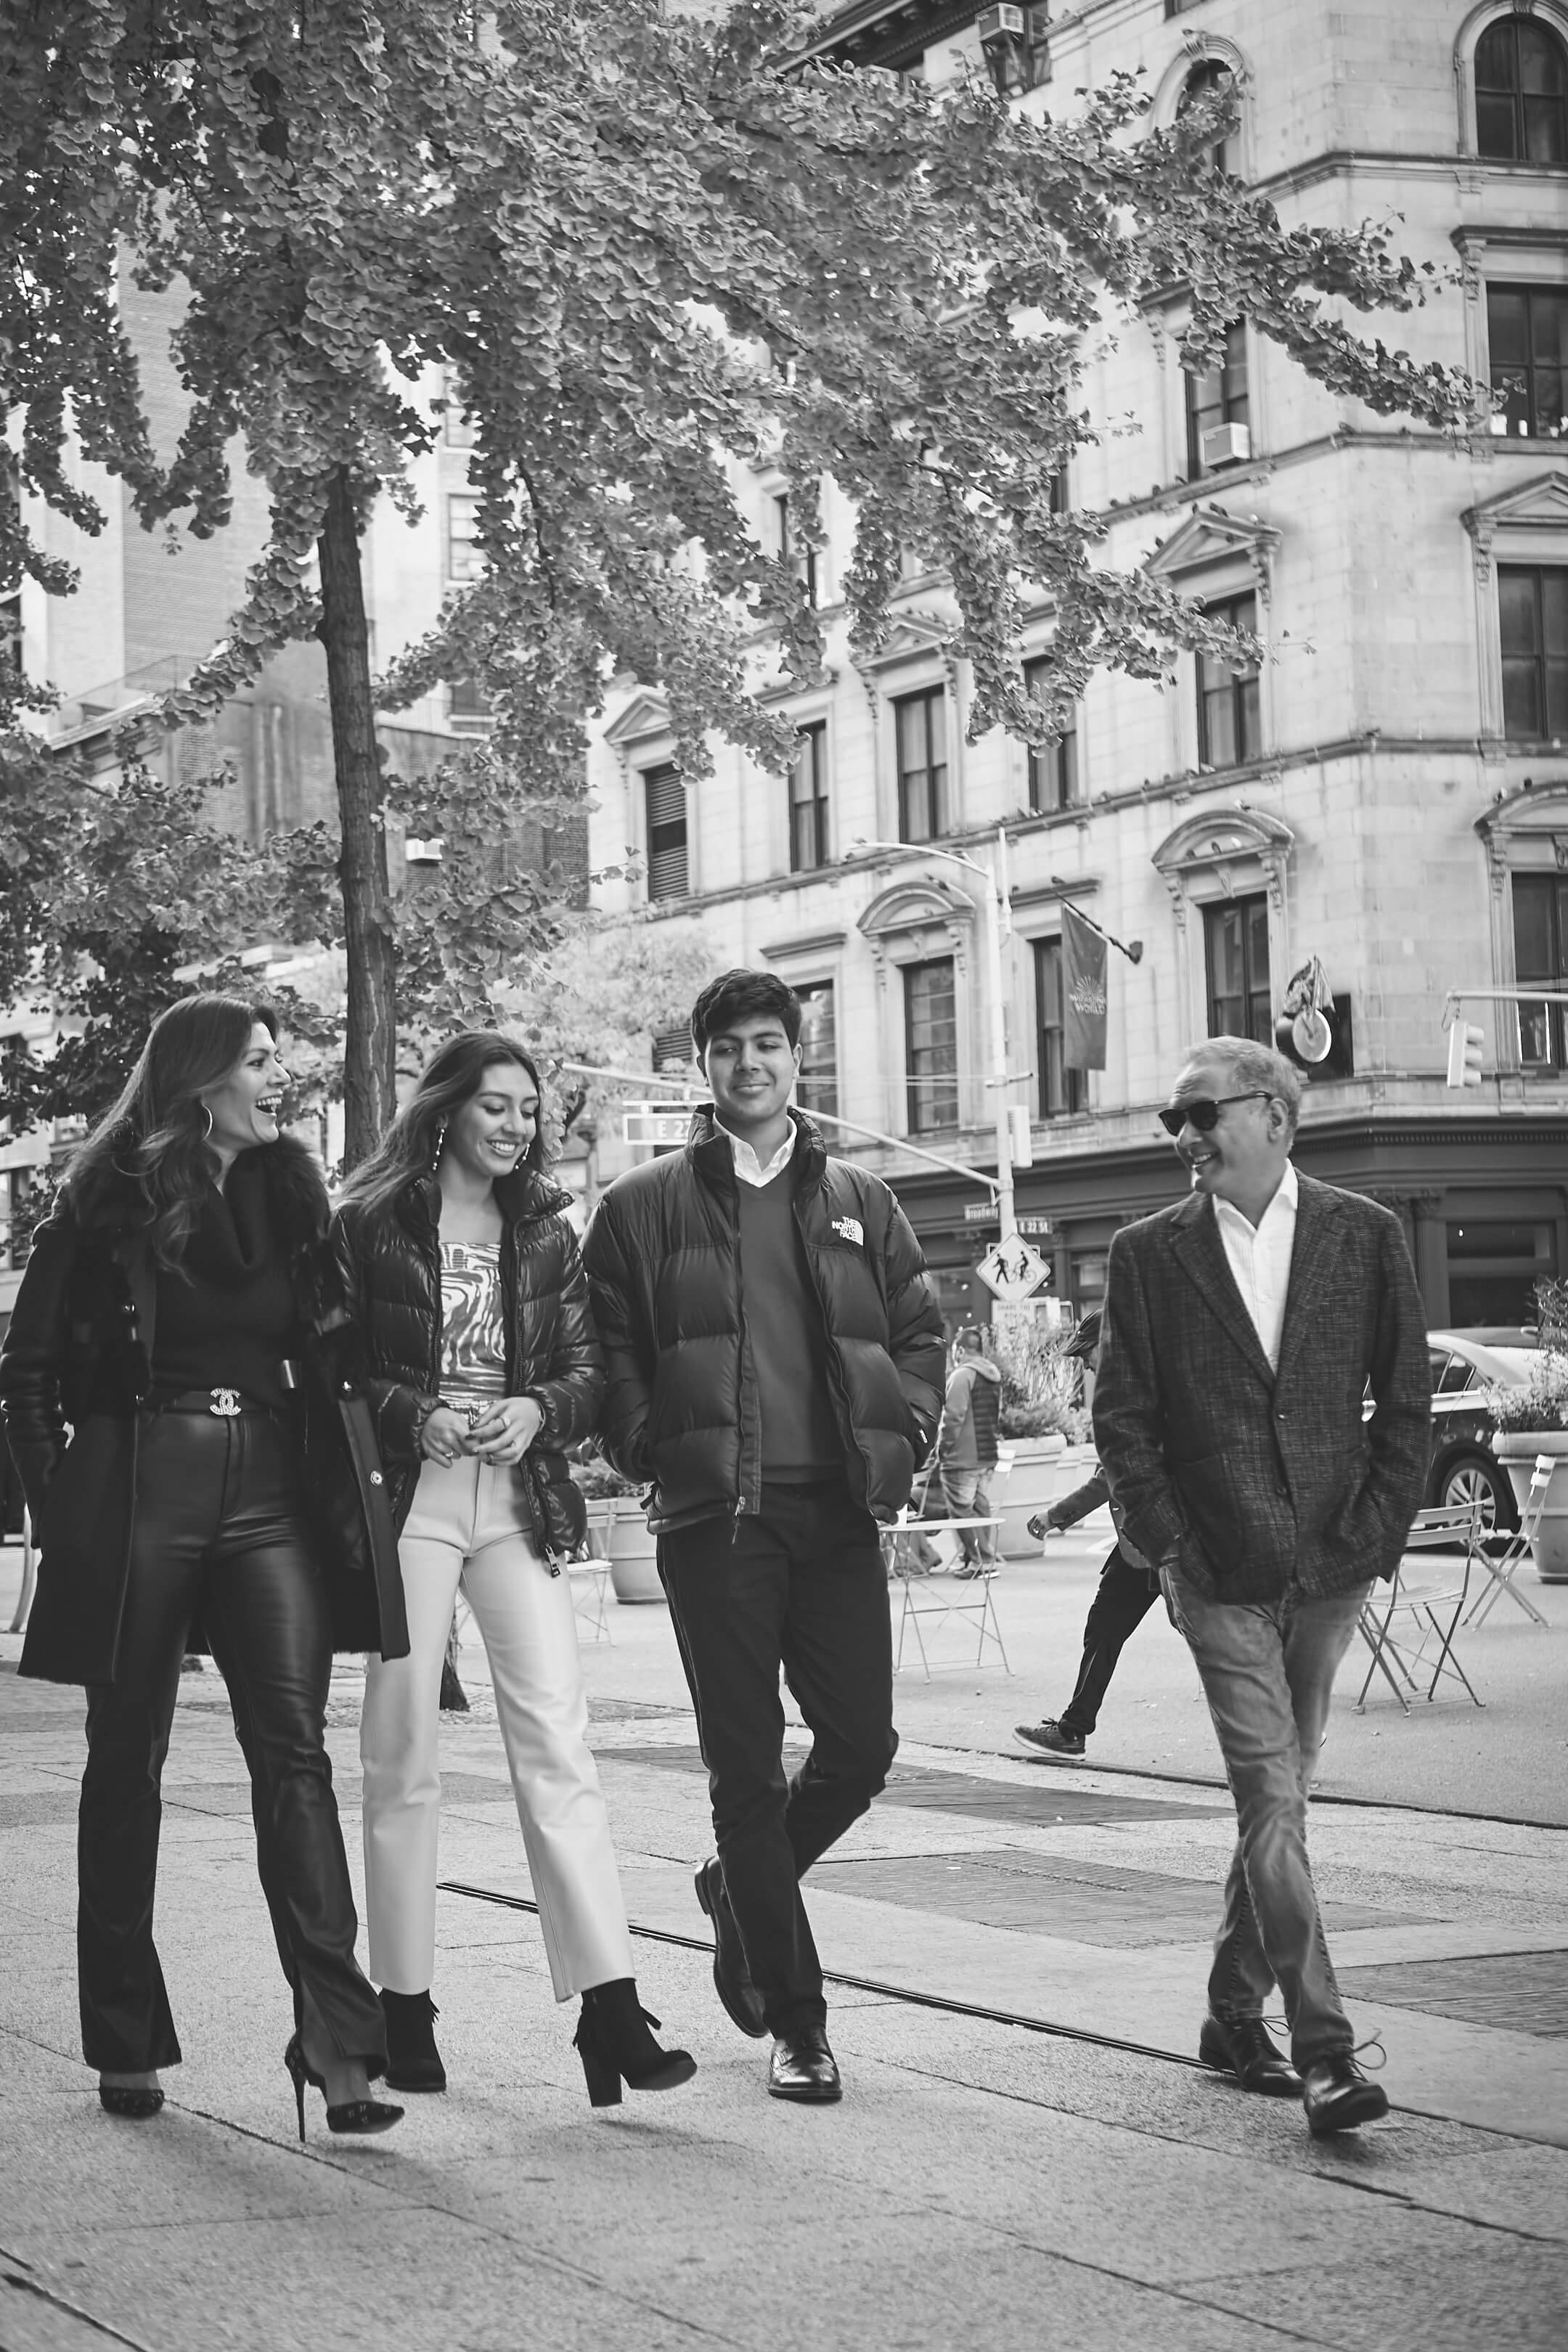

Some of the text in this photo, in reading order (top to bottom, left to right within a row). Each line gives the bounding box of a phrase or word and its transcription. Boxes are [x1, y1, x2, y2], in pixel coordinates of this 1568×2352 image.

[657, 1120, 666, 1138] E
[966, 1206, 998, 1220] Broadway
[832, 1220, 856, 1233] NORTH
[842, 1216, 857, 1226] THE
[1027, 1222, 1037, 1233] 22
[840, 1230, 856, 1241] FACE
